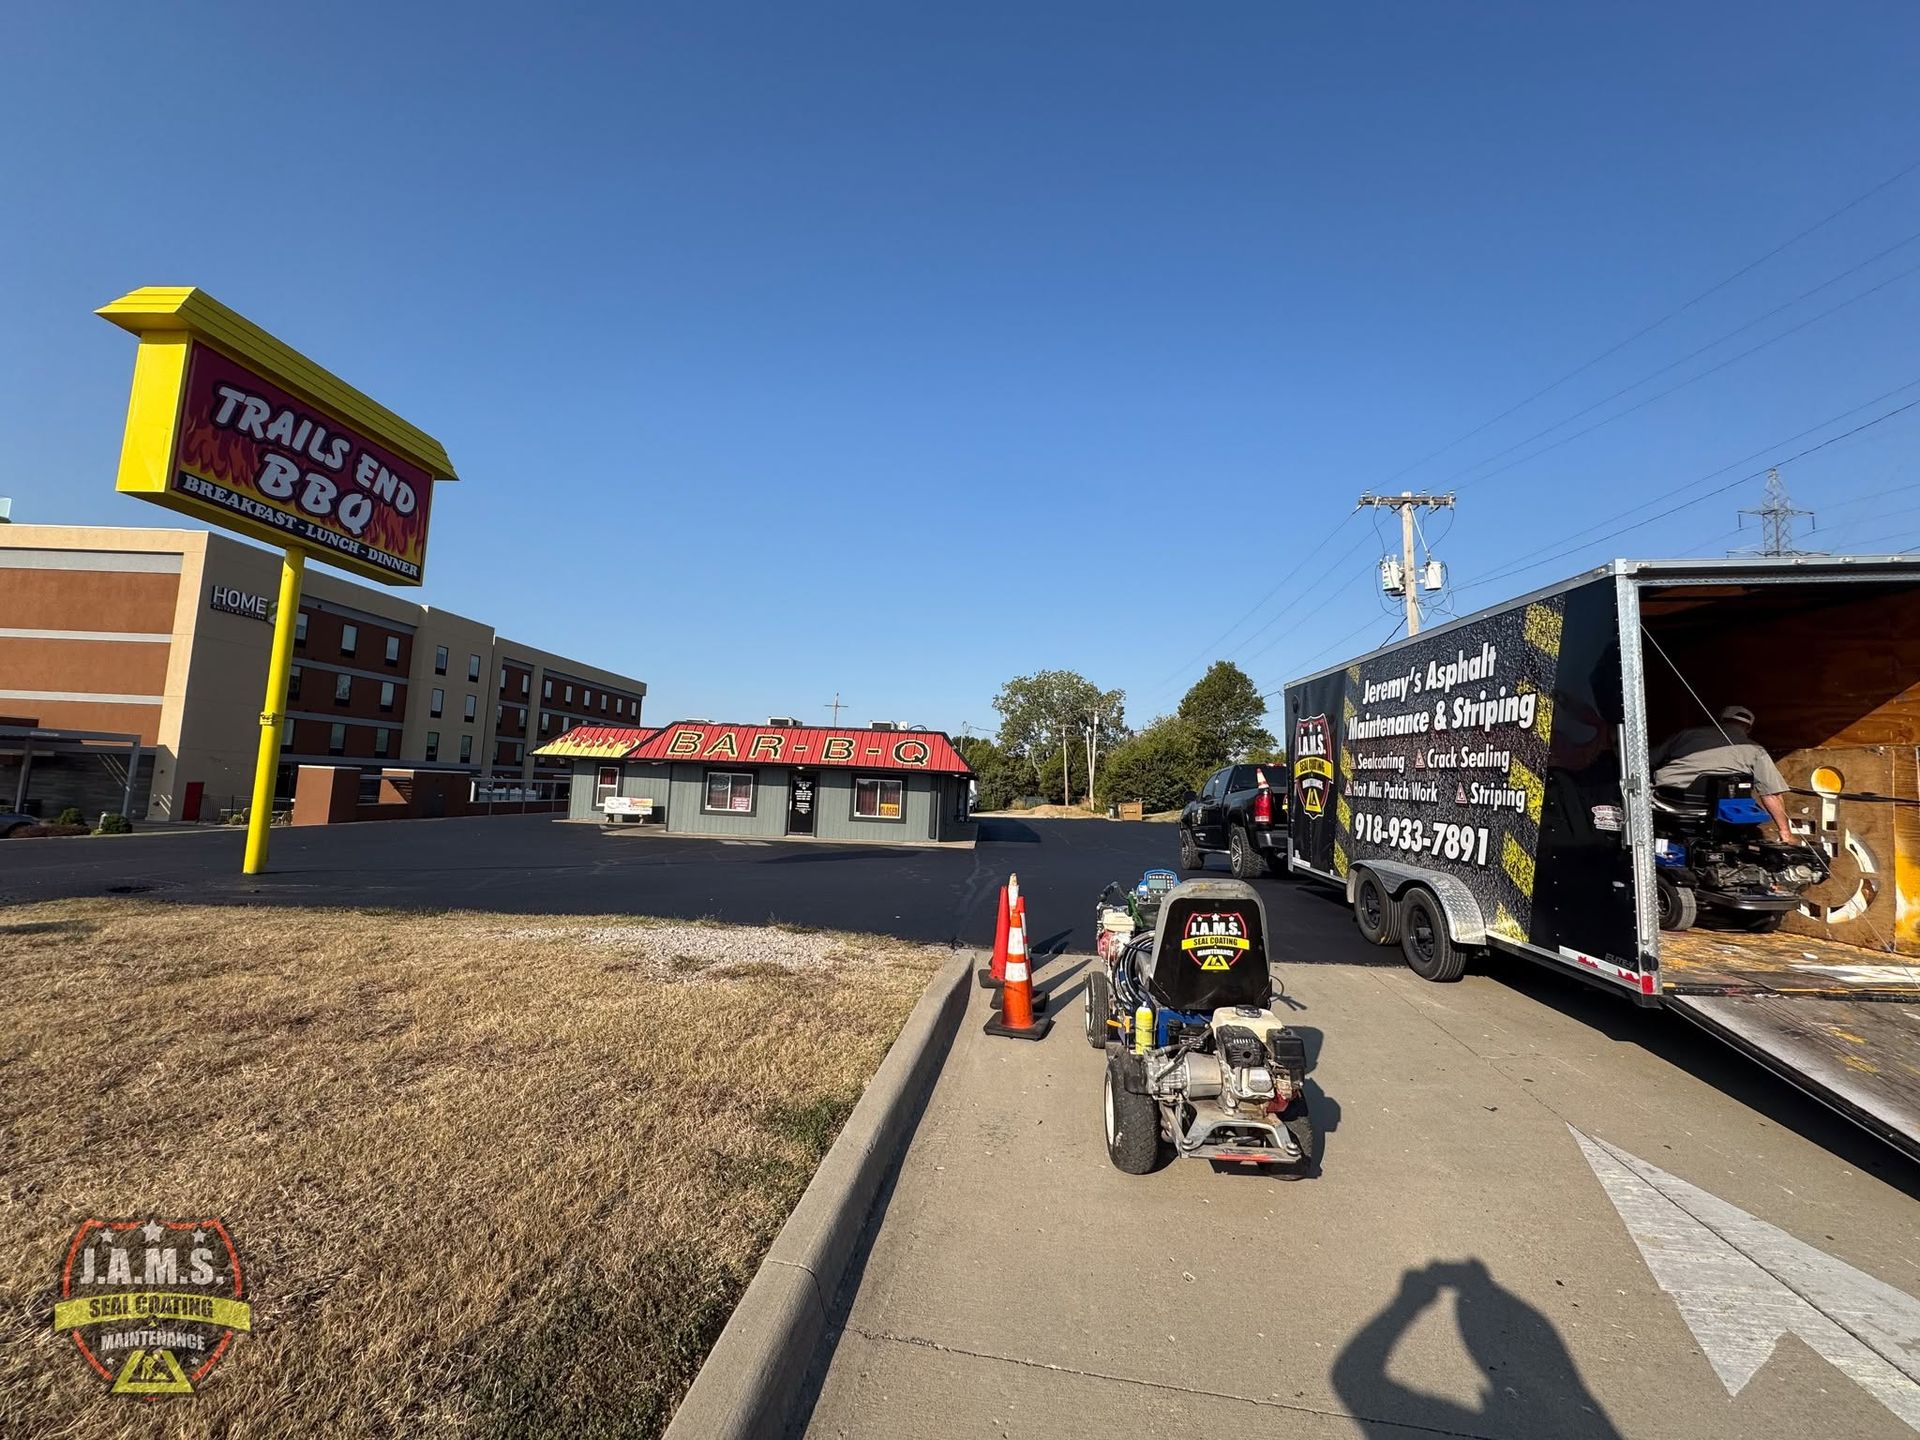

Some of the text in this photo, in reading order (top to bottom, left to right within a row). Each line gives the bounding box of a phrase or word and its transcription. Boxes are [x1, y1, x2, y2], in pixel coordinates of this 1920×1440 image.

[216, 385, 418, 515] TRAILS END
[256, 452, 375, 536] BBQ
[213, 585, 268, 615] HOME
[1362, 642, 1497, 705] Jeremy's Asphalt
[1348, 686, 1537, 741] Maintenance & Striping
[667, 729, 931, 767] BAR-B-Q
[1357, 742, 1510, 774] Sealcoating Crack Sealing
[1353, 780, 1526, 814] Hot Mix Patch Work Striping
[1355, 812, 1490, 866] 918-933-7891
[1190, 922, 1241, 936] J.A.M.S.
[1193, 937, 1238, 946] SEAL COATING
